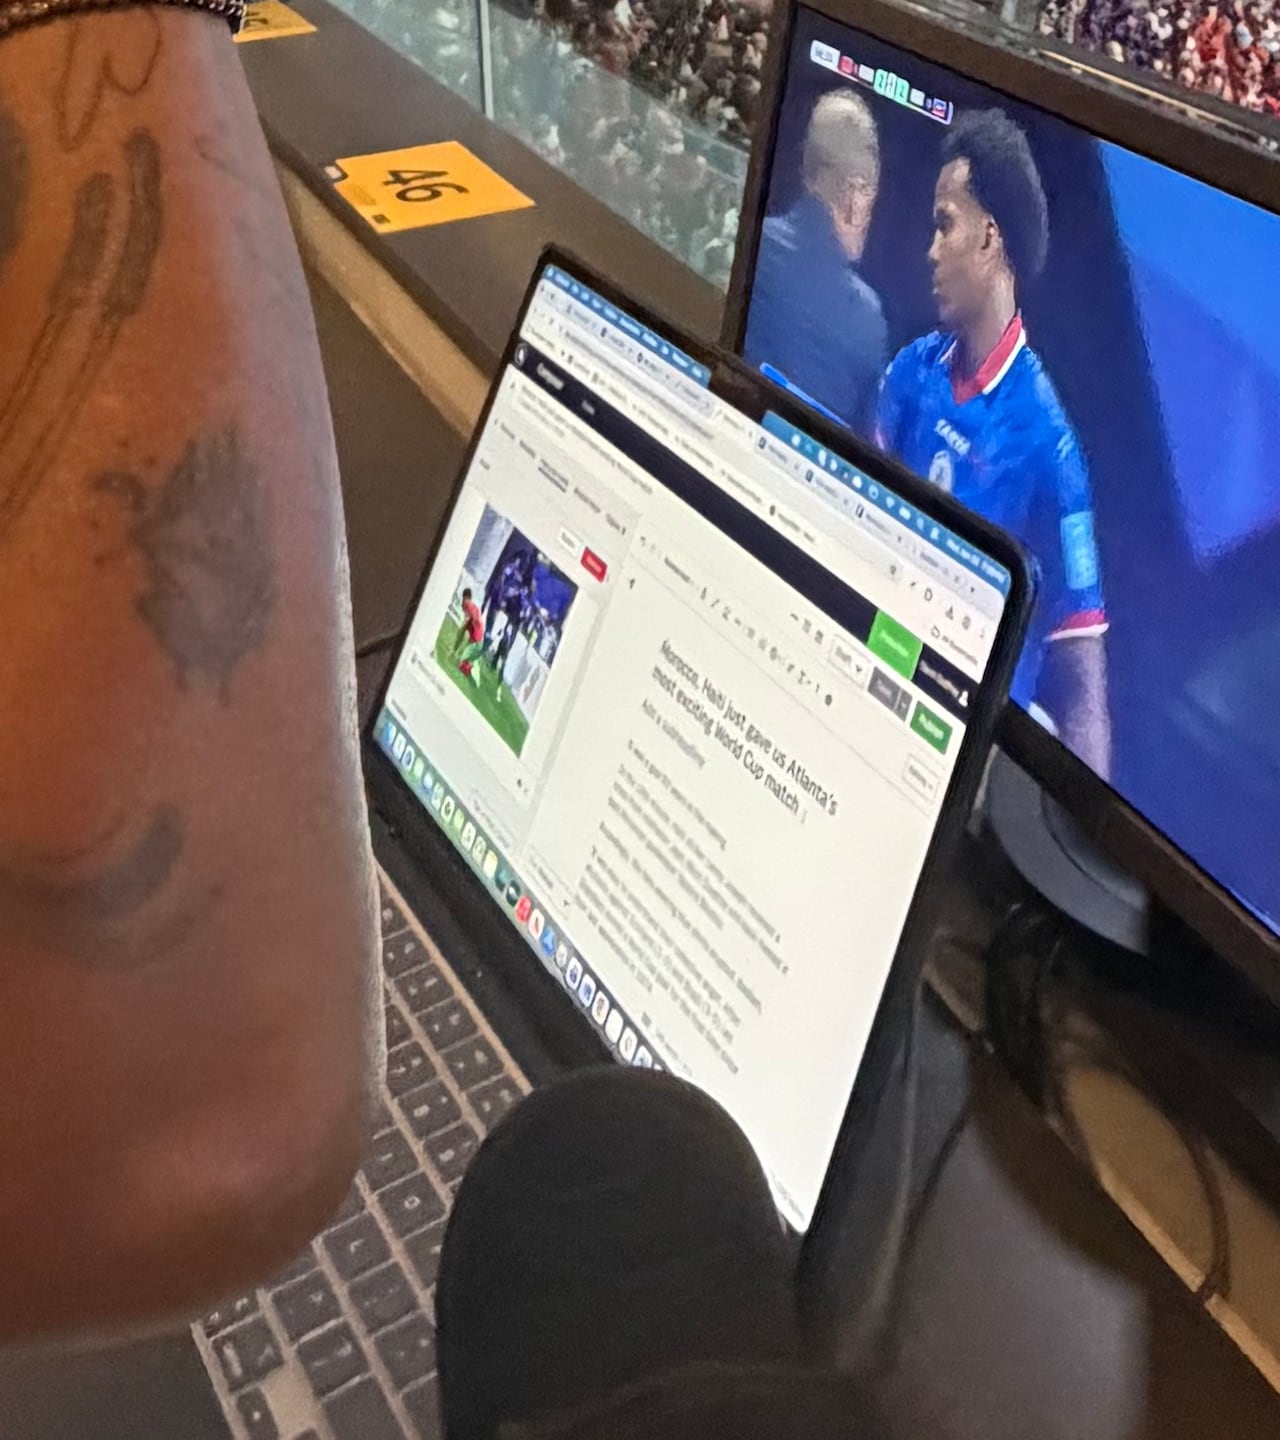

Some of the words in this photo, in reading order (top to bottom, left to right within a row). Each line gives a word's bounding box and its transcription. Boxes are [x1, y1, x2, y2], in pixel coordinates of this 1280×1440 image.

[383, 169, 469, 203] 46
[713, 723, 744, 761] World
[742, 750, 765, 782] Cup
[764, 772, 800, 815] match
[722, 701, 747, 732] just
[746, 722, 773, 757] gave
[772, 747, 787, 770] us
